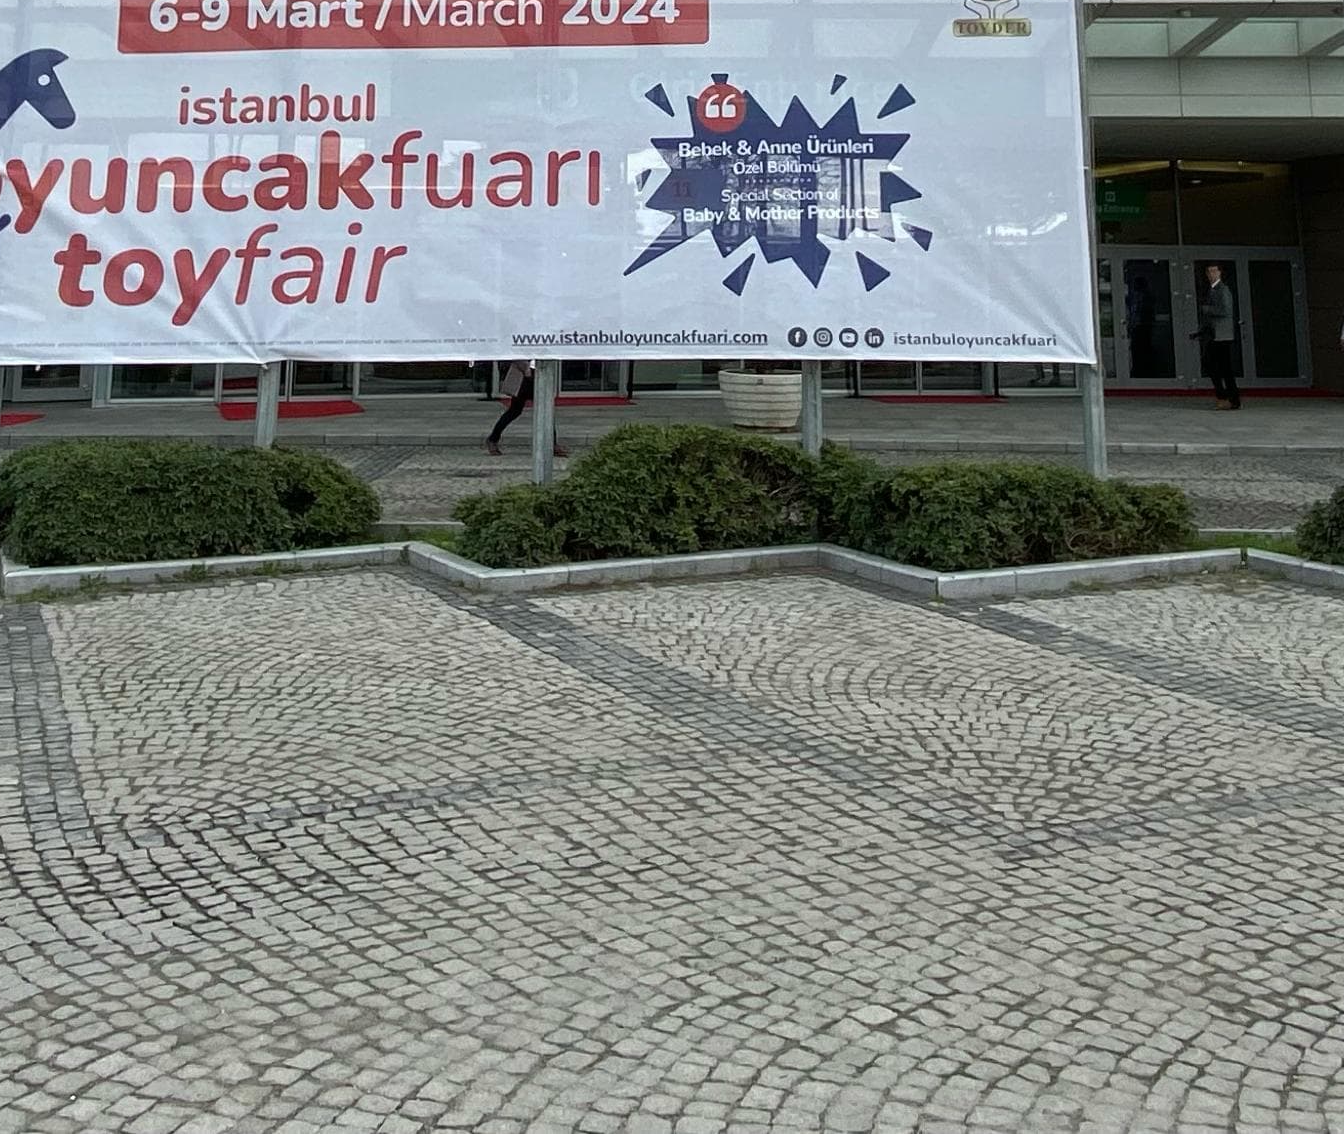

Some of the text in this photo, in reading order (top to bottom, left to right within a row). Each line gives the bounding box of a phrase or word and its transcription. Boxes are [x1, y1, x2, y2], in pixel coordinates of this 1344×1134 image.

[178, 82, 377, 126] istanbul
[678, 134, 874, 157] Bebek & Anne Ürünleri
[733, 159, 764, 175] Özel
[721, 188, 770, 203] Special
[773, 188, 823, 201] Section
[683, 204, 881, 224] Baby & Mother Products
[53, 222, 409, 328] toyfair
[511, 329, 769, 347] www.istanbuloyuncakfuari.com
[893, 331, 1058, 348] istanbuloyuncakfuari
